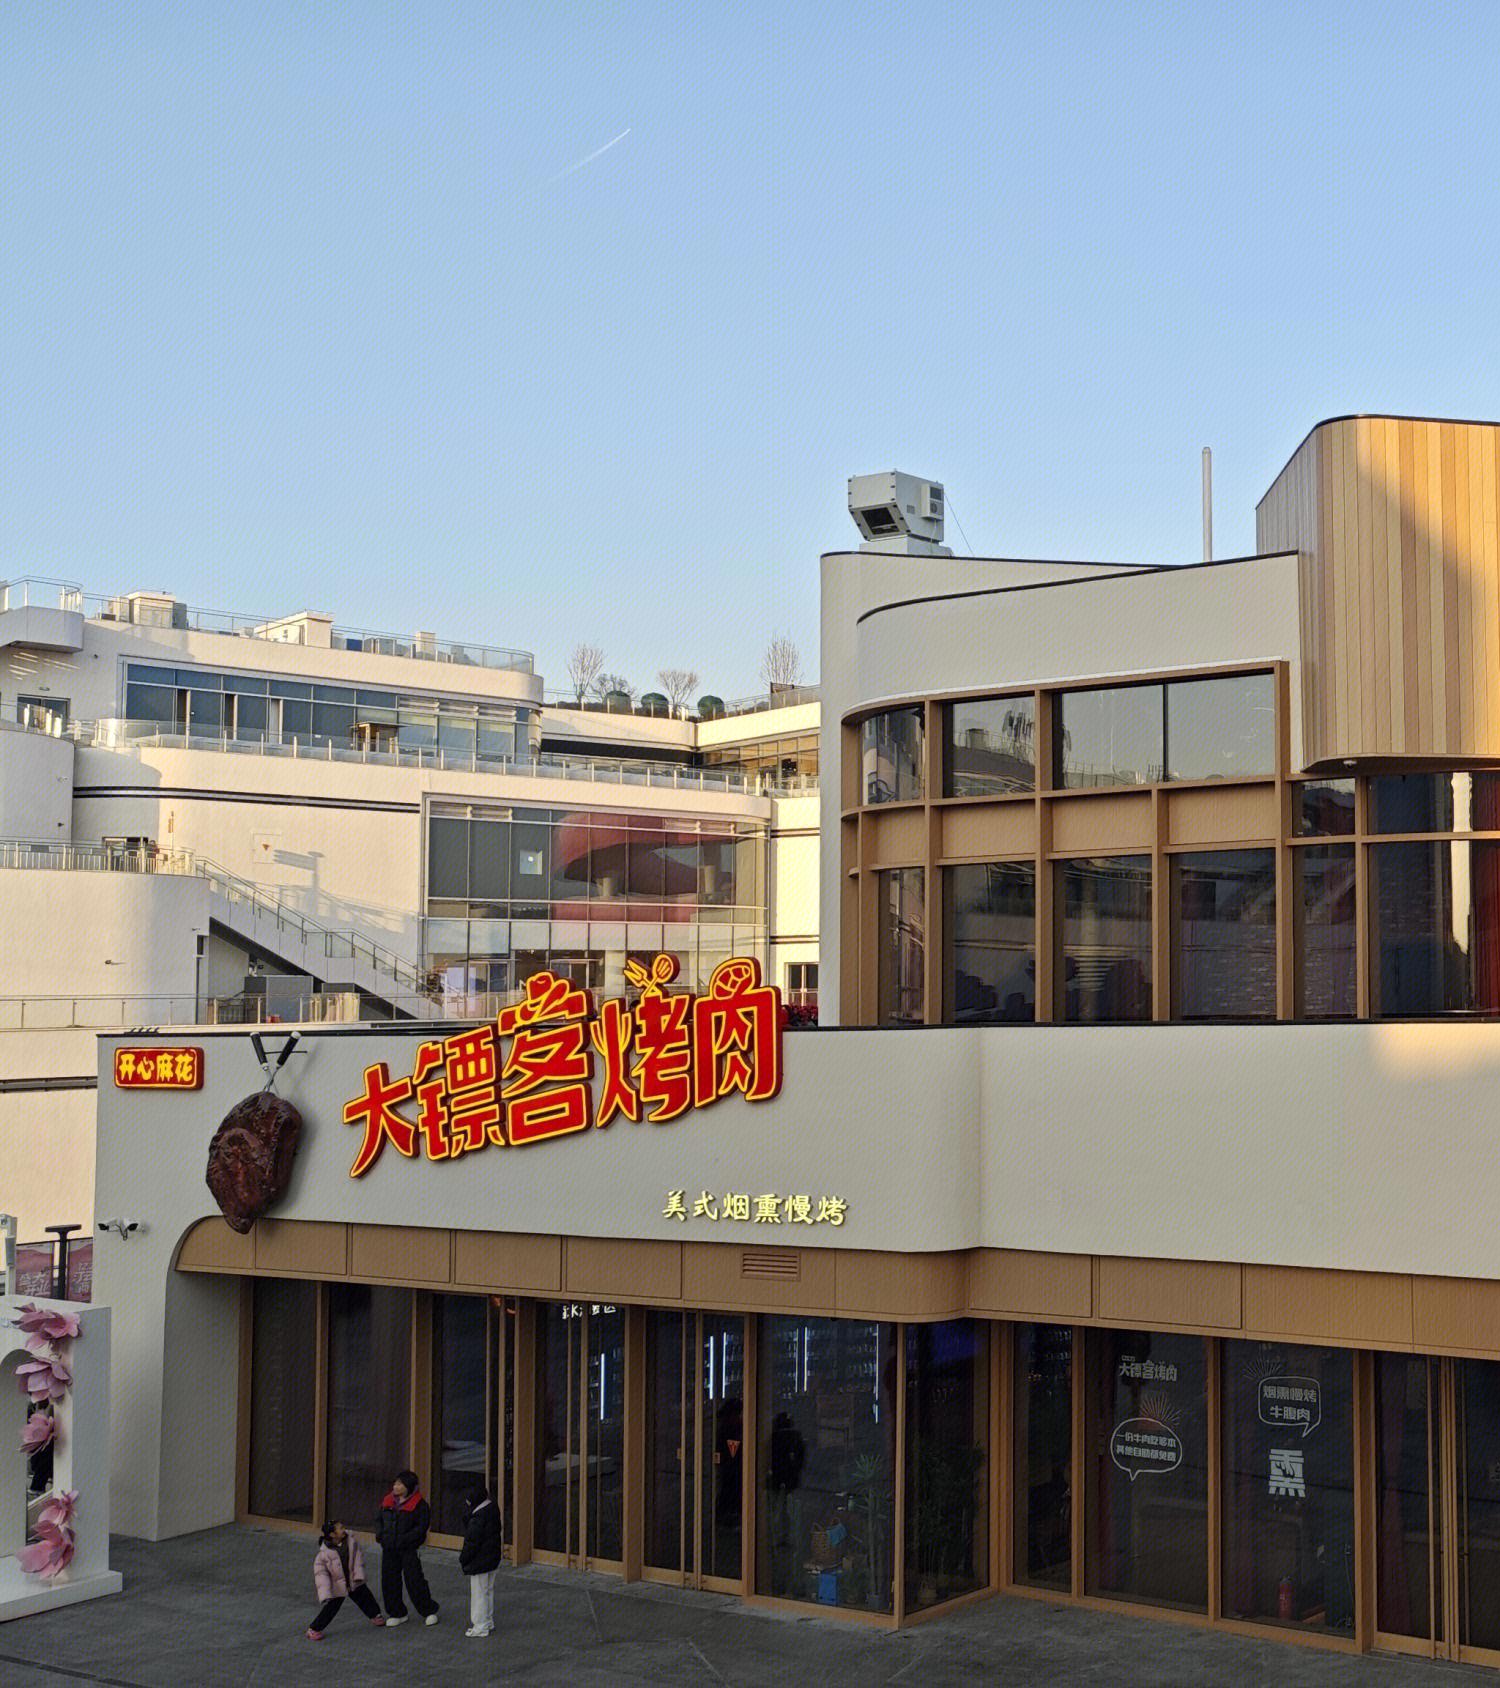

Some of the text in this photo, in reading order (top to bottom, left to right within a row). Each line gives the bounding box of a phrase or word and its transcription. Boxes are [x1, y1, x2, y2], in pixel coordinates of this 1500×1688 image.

[118, 1052, 194, 1083] 开心麻花
[343, 955, 784, 1178] 大镖客烤肉
[661, 1189, 848, 1227] 美式烟熏慢烤
